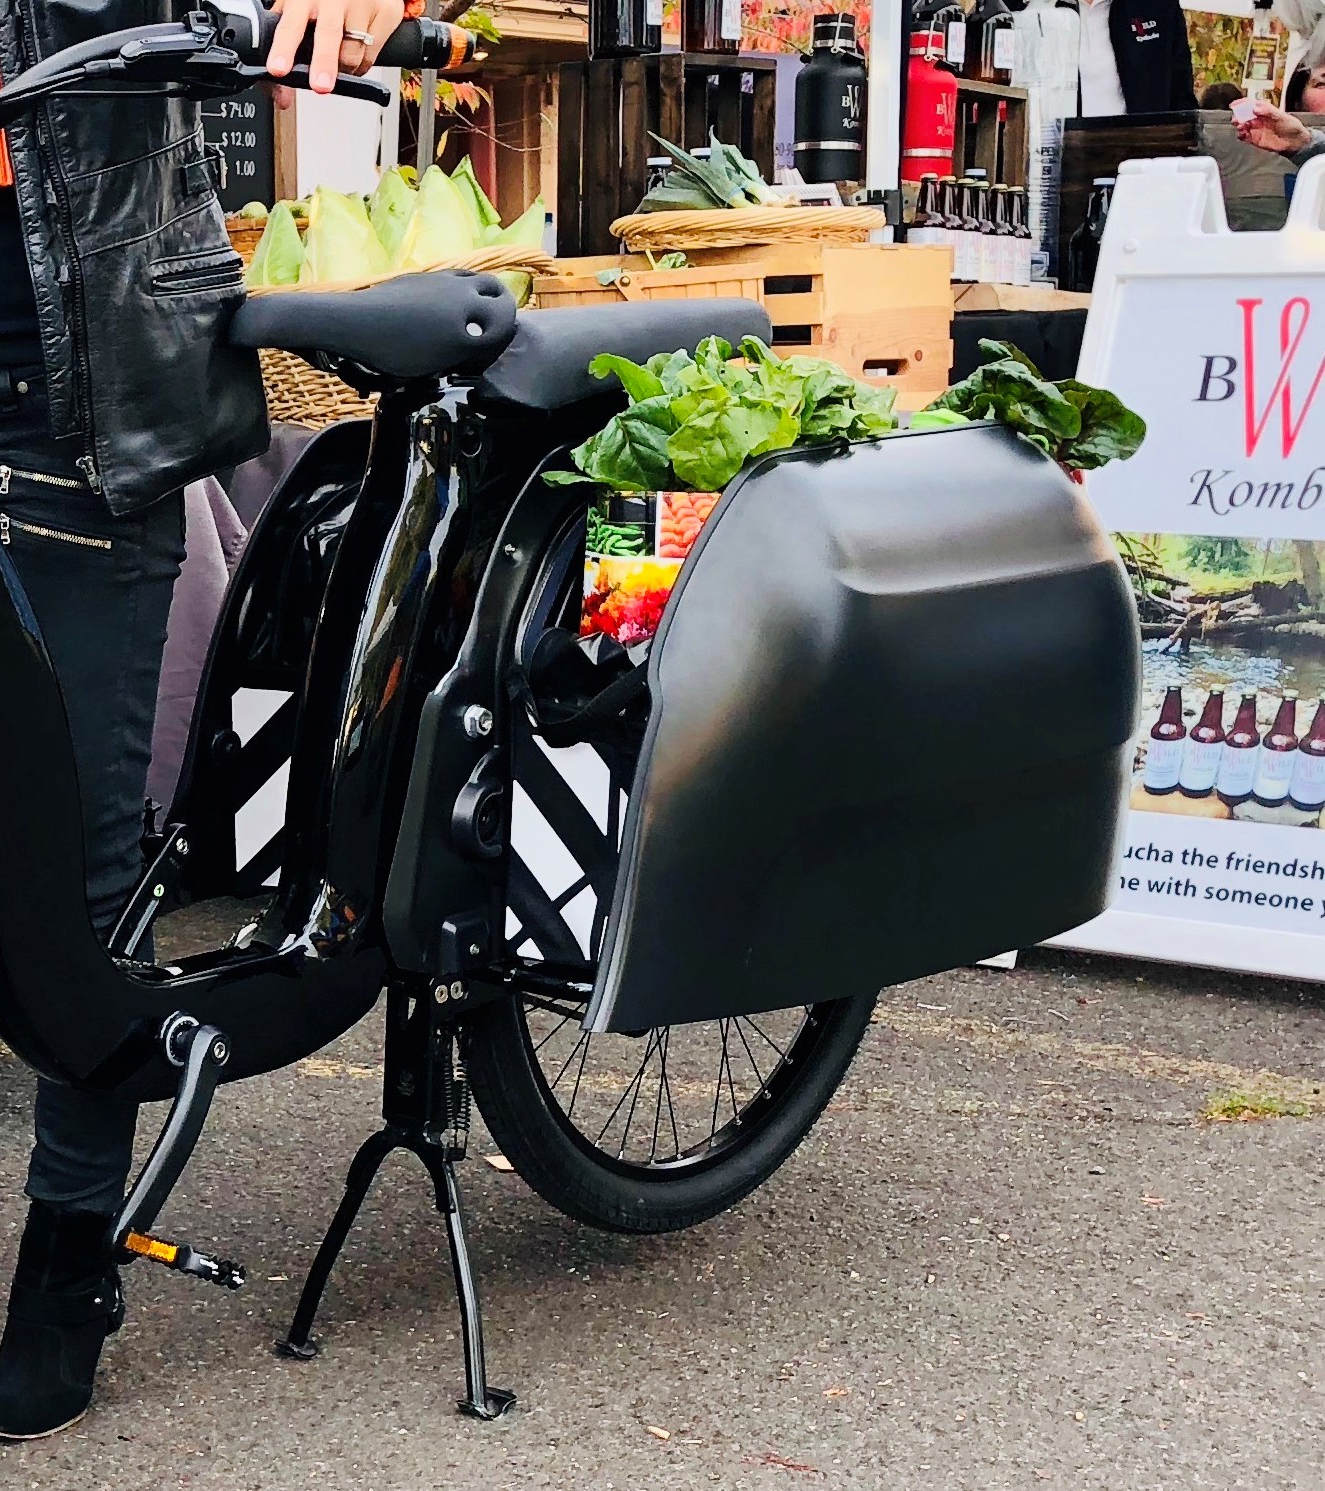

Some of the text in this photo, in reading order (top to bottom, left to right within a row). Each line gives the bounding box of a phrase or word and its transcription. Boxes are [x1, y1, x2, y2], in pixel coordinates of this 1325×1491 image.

[1181, 848, 1219, 869] the
[1225, 852, 1325, 880] friendsh
[1147, 877, 1197, 897] with
[1204, 886, 1314, 911] someone
